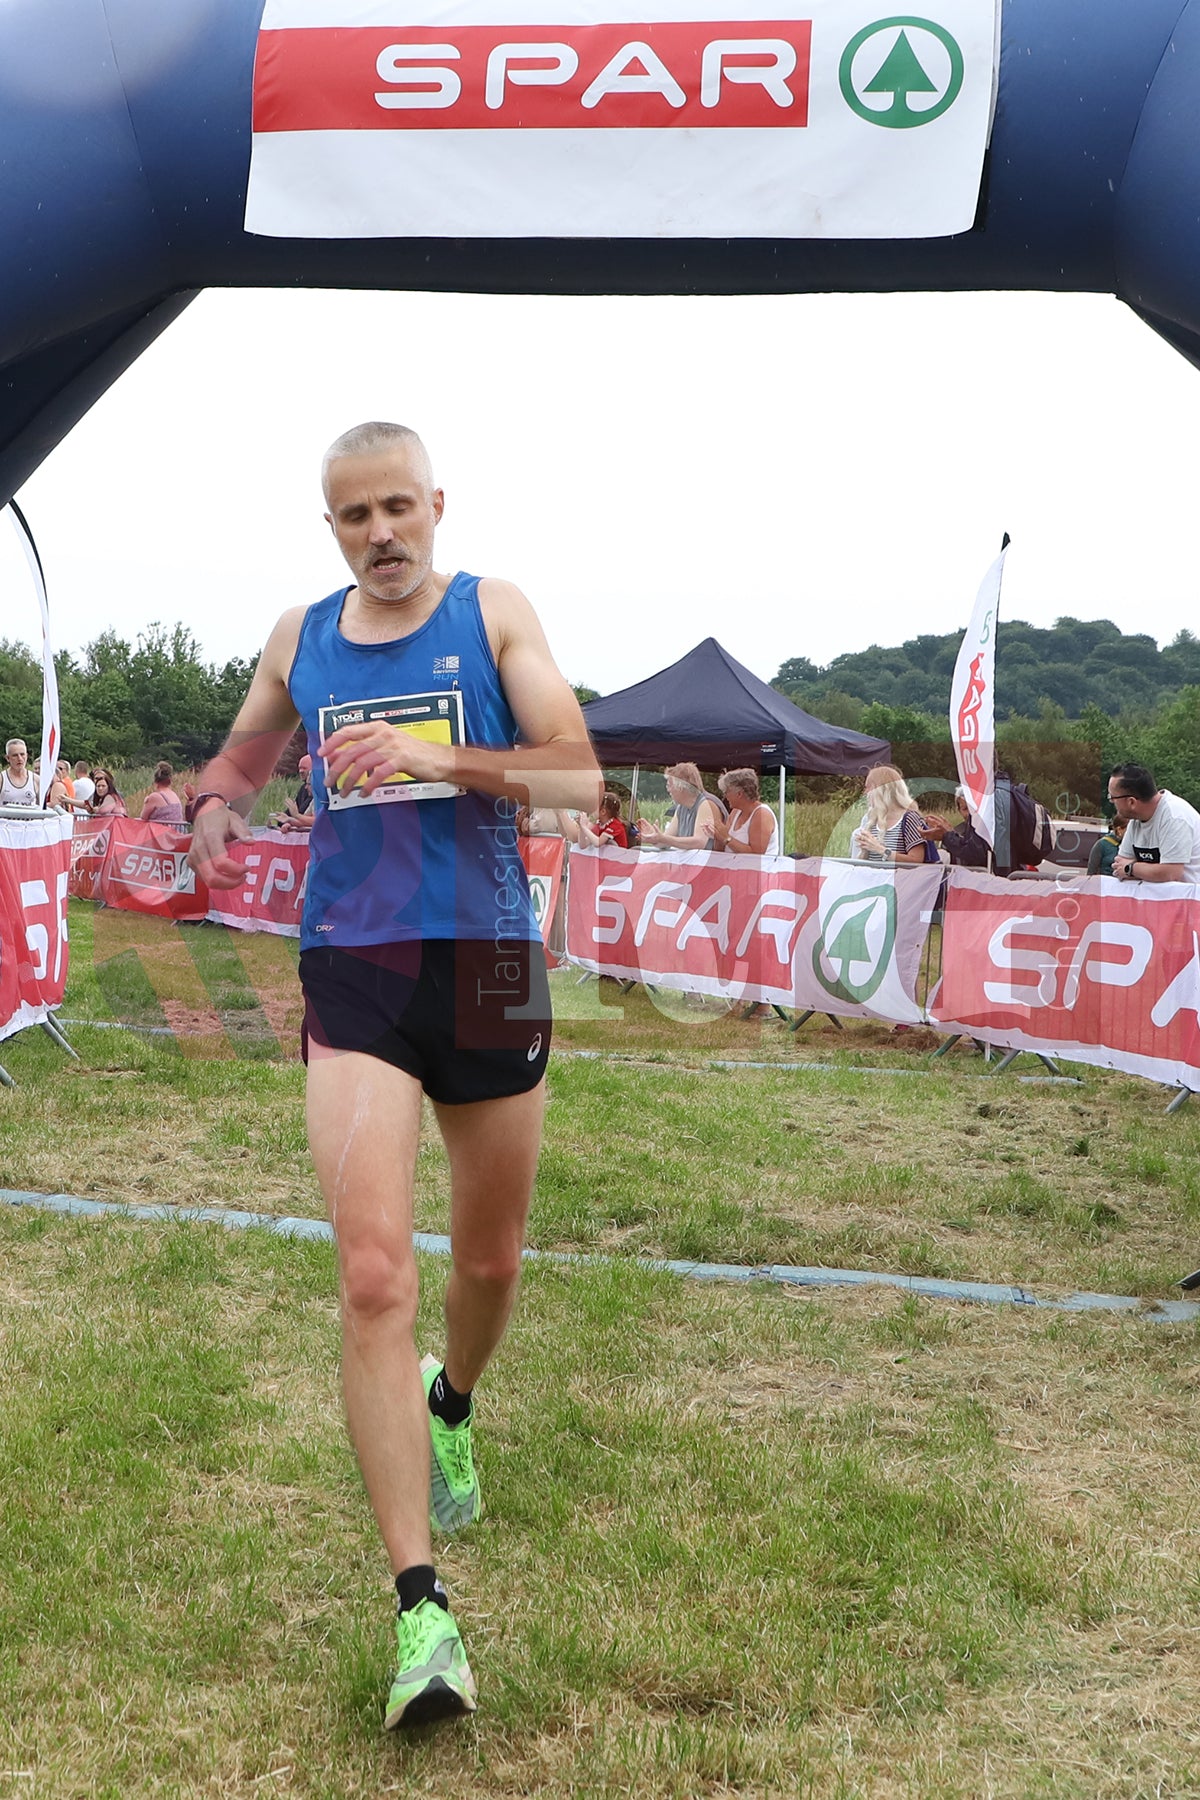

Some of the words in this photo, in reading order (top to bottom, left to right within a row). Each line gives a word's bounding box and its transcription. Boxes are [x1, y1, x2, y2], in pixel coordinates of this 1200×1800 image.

[375, 39, 797, 110] SPAR
[120, 853, 175, 883] SPAR
[592, 876, 808, 964] SPAR
